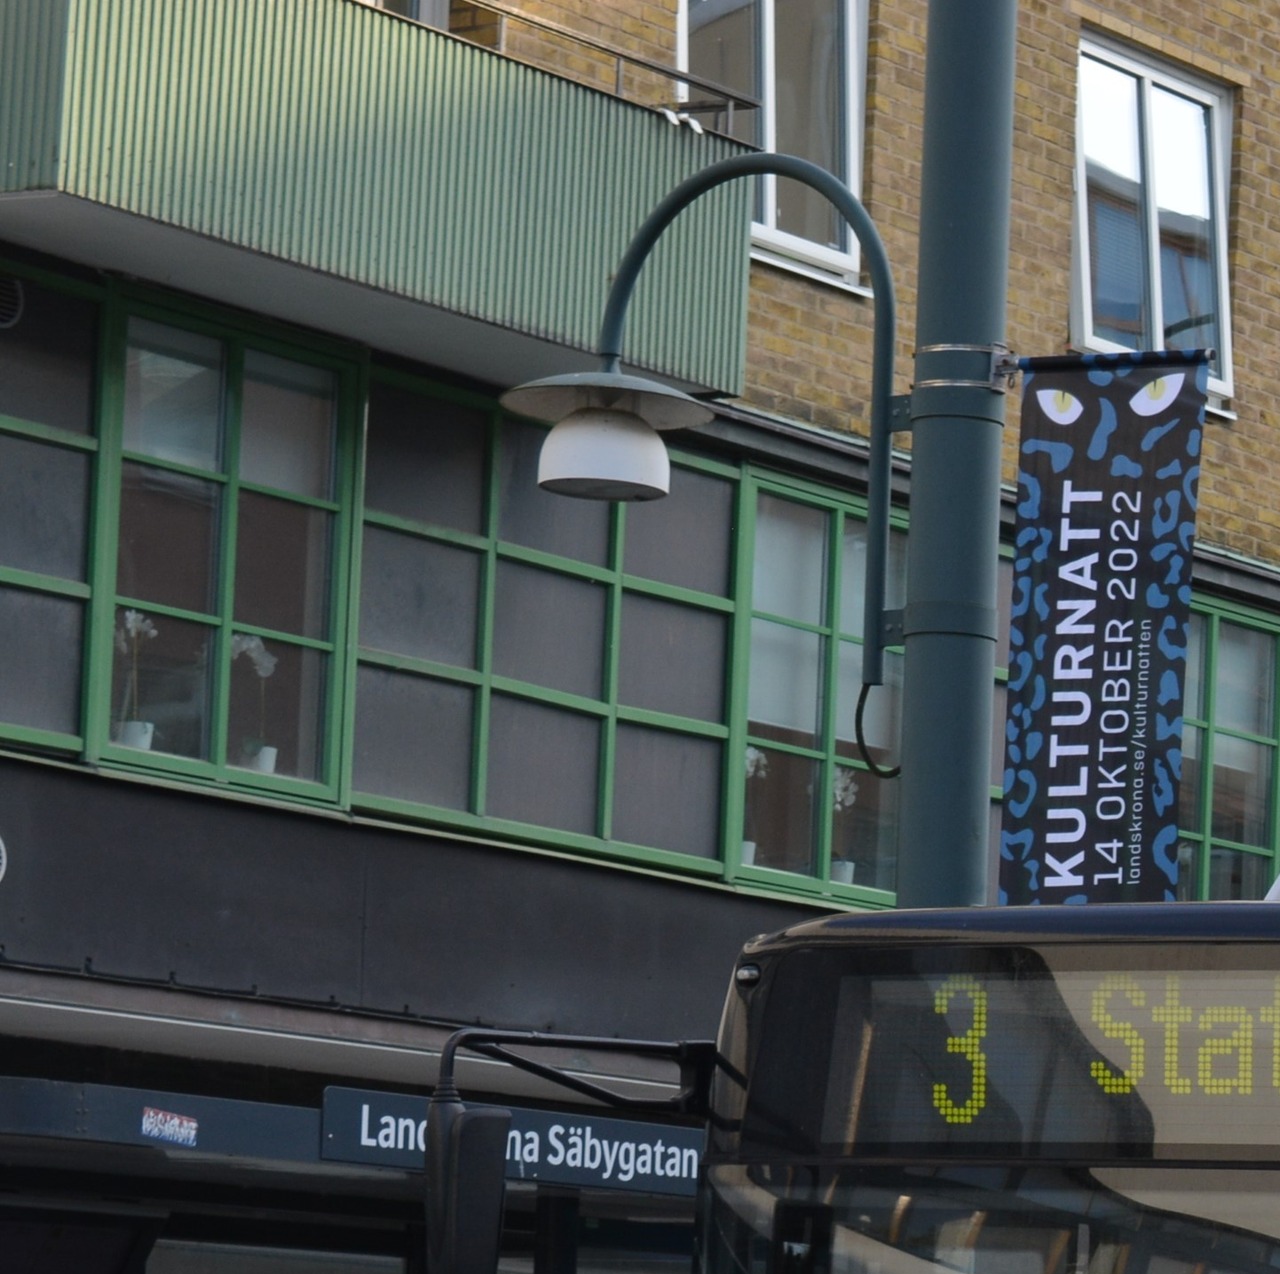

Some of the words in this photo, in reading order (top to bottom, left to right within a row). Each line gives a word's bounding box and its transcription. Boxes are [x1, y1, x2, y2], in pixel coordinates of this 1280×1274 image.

[1107, 490, 1142, 600] 2022
[1044, 480, 1103, 888] KULTURNATT
[1096, 618, 1134, 822] OKTOBER
[1126, 618, 1152, 885] landskrona.se/kulturnatten
[1094, 838, 1124, 886] 14
[933, 974, 987, 1124] 3
[361, 1104, 539, 1163] Lanna
[547, 1125, 698, 1182] Säbygatan
